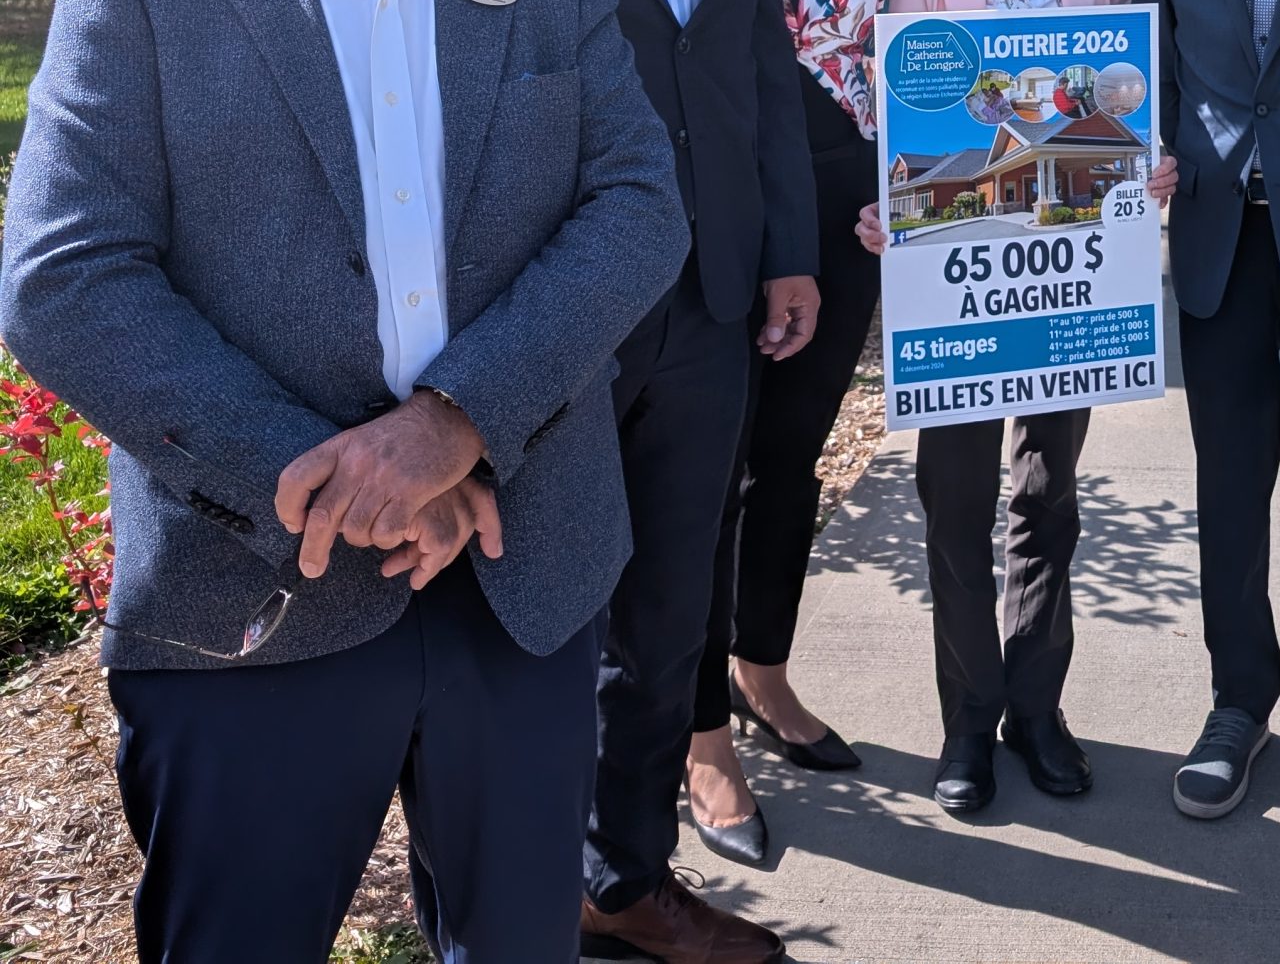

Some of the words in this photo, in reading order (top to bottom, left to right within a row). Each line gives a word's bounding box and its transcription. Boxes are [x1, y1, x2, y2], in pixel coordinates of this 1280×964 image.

[907, 40, 943, 50] Maison
[983, 33, 1069, 59] LOTERIE
[1072, 29, 1129, 55] 2026
[907, 50, 954, 60] Catherine
[907, 62, 921, 71] De
[924, 60, 965, 71] Longpré
[1116, 188, 1144, 200] BILLET
[1113, 201, 1133, 217] 20
[1137, 199, 1145, 216] $
[944, 244, 992, 284] 65
[1002, 237, 1074, 279] 000
[1084, 231, 1103, 274] $
[959, 285, 979, 319] À
[984, 280, 1093, 316] GAGNER
[1090, 313, 1105, 325] prix
[1106, 312, 1116, 320] de
[1117, 309, 1133, 320] 500
[1134, 309, 1139, 318] $
[1063, 330, 1073, 338] au
[1093, 324, 1109, 336] prix
[1110, 323, 1120, 332] de
[1121, 322, 1126, 330] 1
[1127, 321, 1143, 330] 000
[1144, 319, 1149, 329] $
[900, 340, 926, 361] 45
[930, 336, 998, 361] tirages
[1094, 336, 1109, 348] prix
[1110, 335, 1120, 344] de
[1121, 334, 1126, 343] 5
[1128, 332, 1143, 342] 000
[1144, 331, 1150, 340] $
[1069, 351, 1084, 363] prix
[1085, 350, 1095, 359] de
[1096, 348, 1107, 357] 10
[1108, 346, 1123, 356] 000
[1124, 345, 1130, 355] $
[931, 362, 944, 370] 2026
[896, 380, 994, 417] BILLETS
[1001, 375, 1034, 404] EN
[1039, 366, 1117, 399] VENTE
[1124, 361, 1156, 389] ICI
